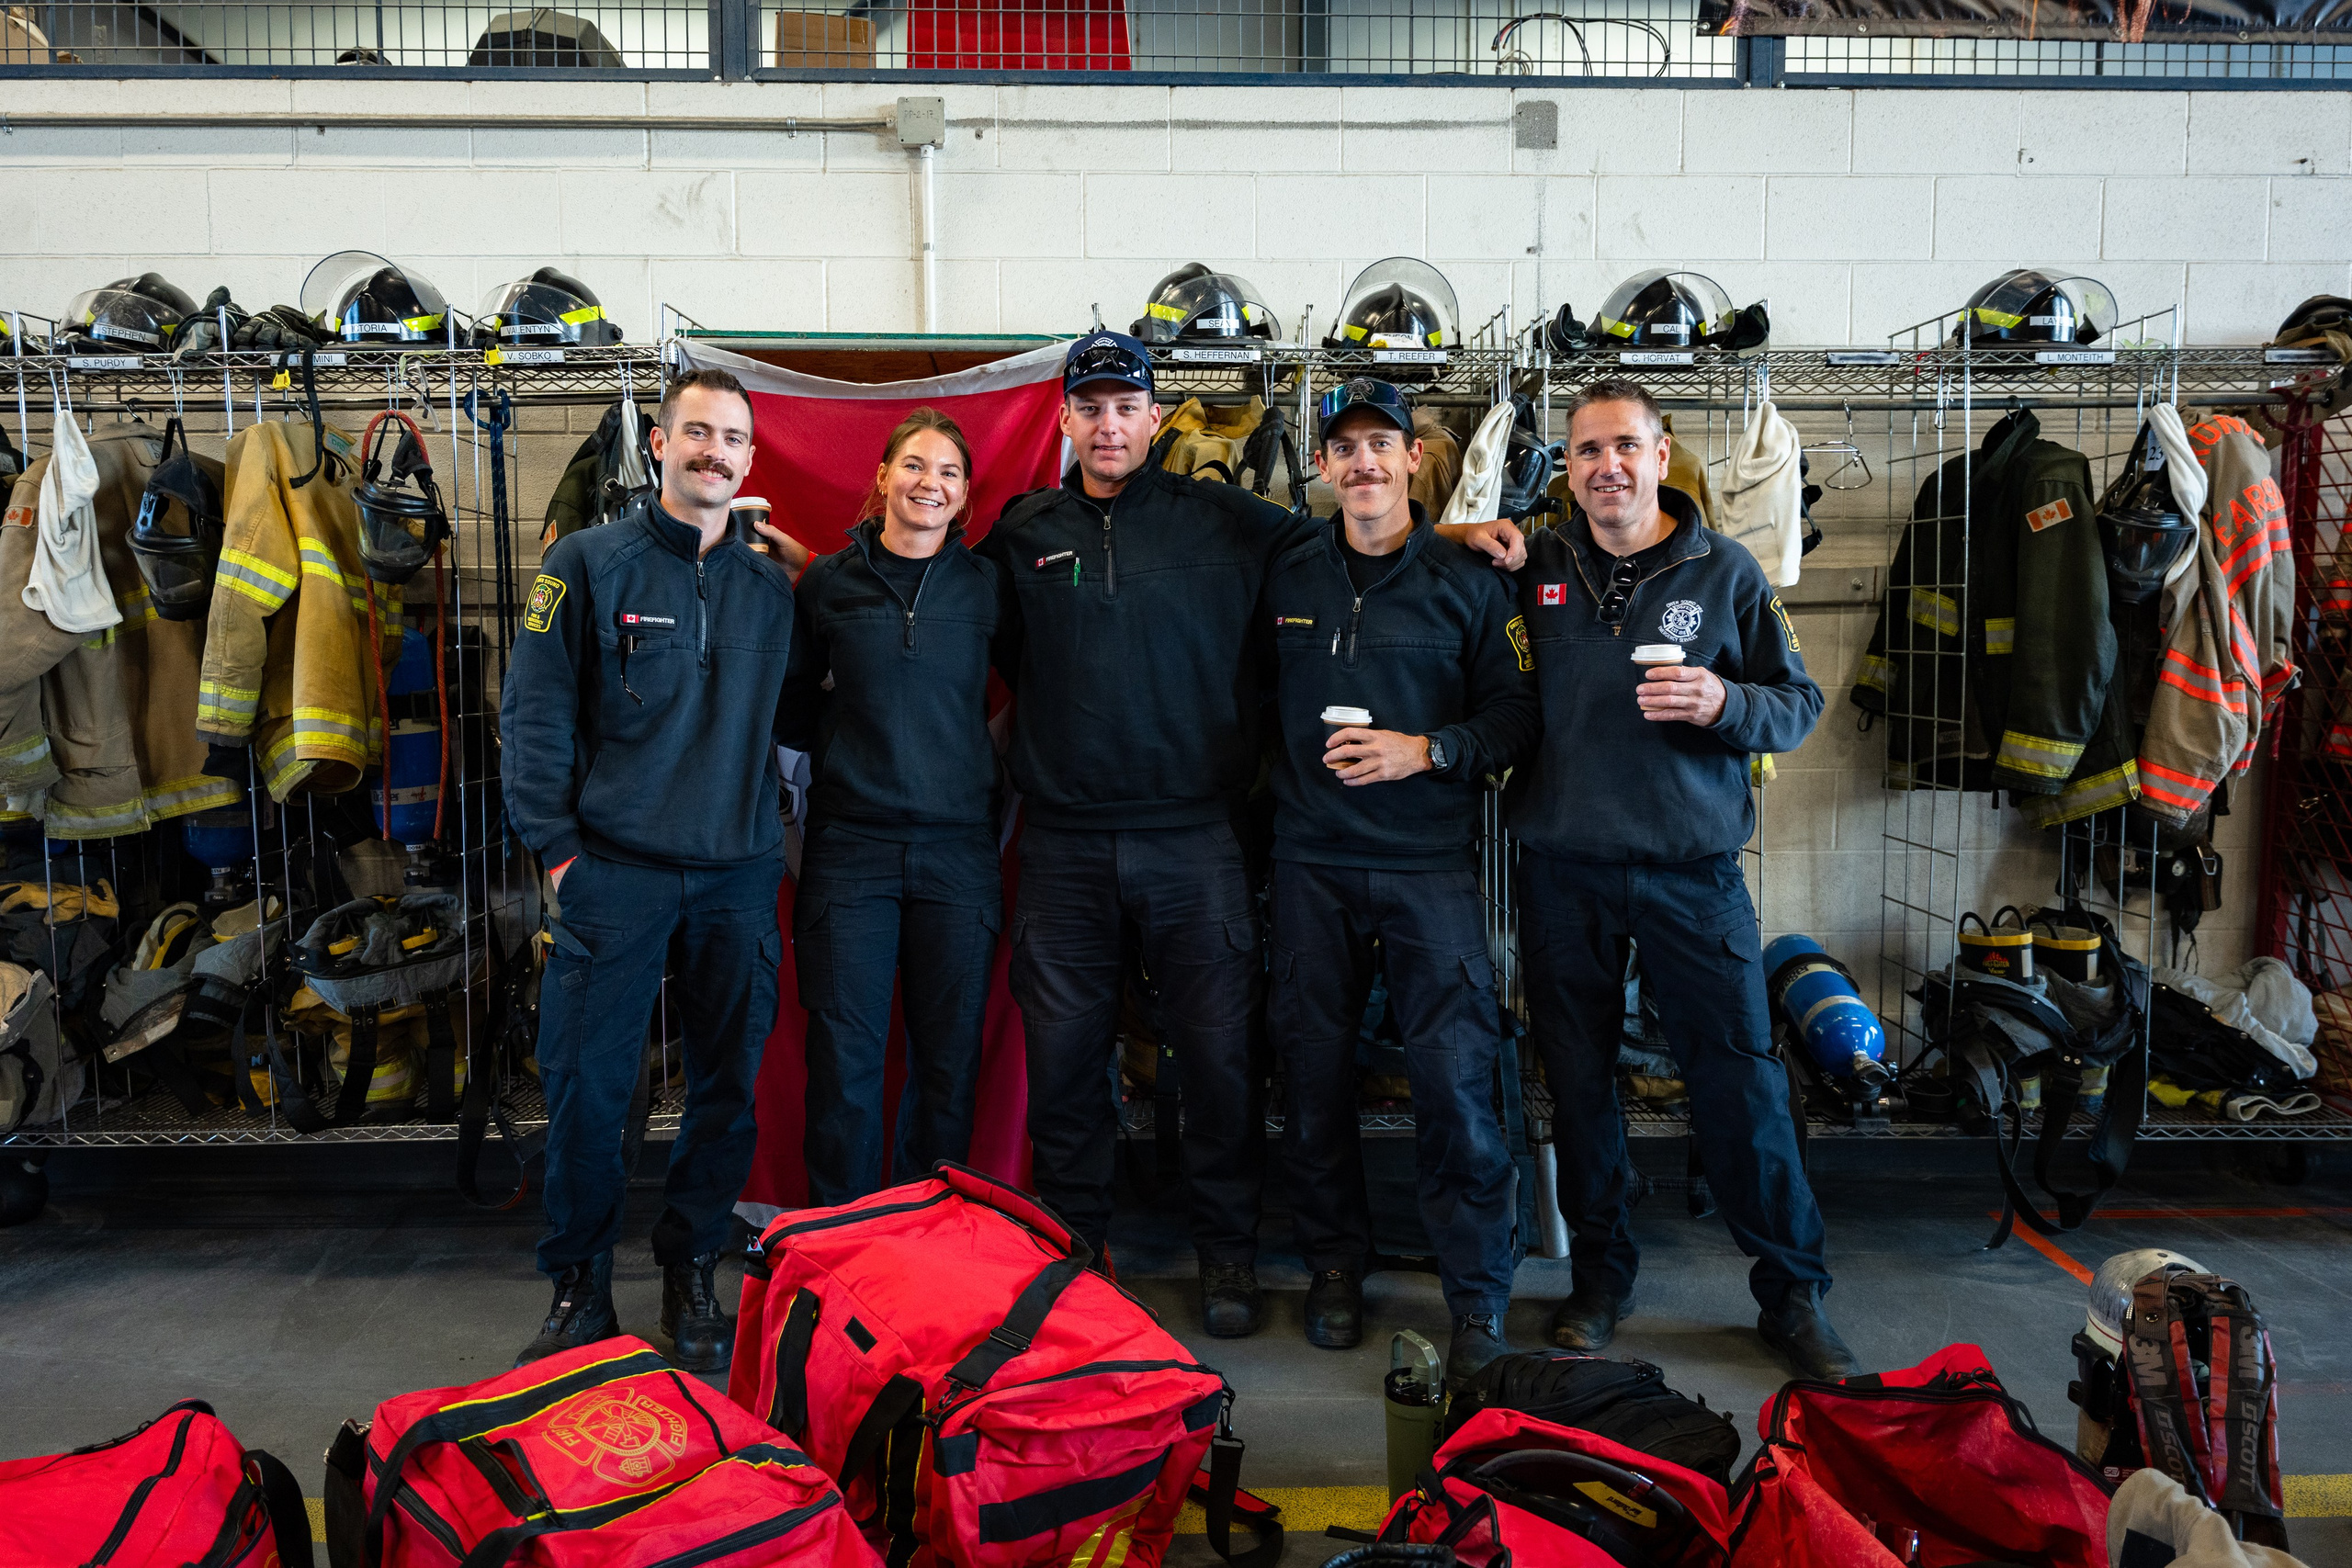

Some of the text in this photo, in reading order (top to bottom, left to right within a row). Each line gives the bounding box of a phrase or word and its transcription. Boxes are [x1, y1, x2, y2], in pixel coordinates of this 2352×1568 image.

[349, 323, 388, 333] ICTORIA
[506, 325, 550, 334] VALENTYN
[1663, 324, 1680, 333] CAL
[101, 326, 146, 342] STEPHEN
[295, 355, 334, 363] TMINI
[506, 352, 551, 360] V. SOBKO
[1182, 351, 1250, 359] S. HEFFERNAN
[1387, 352, 1435, 360] T. REEFER
[1631, 354, 1680, 363] C. HORVAT
[83, 359, 126, 367] S. PURDY
[639, 615, 675, 625] FIREFIGHTER
[2237, 1325, 2265, 1382] 3M
[2128, 1334, 2168, 1386] 3M
[639, 1399, 684, 1448] FIGHTER
[2239, 1423, 2258, 1493] SCOTT
